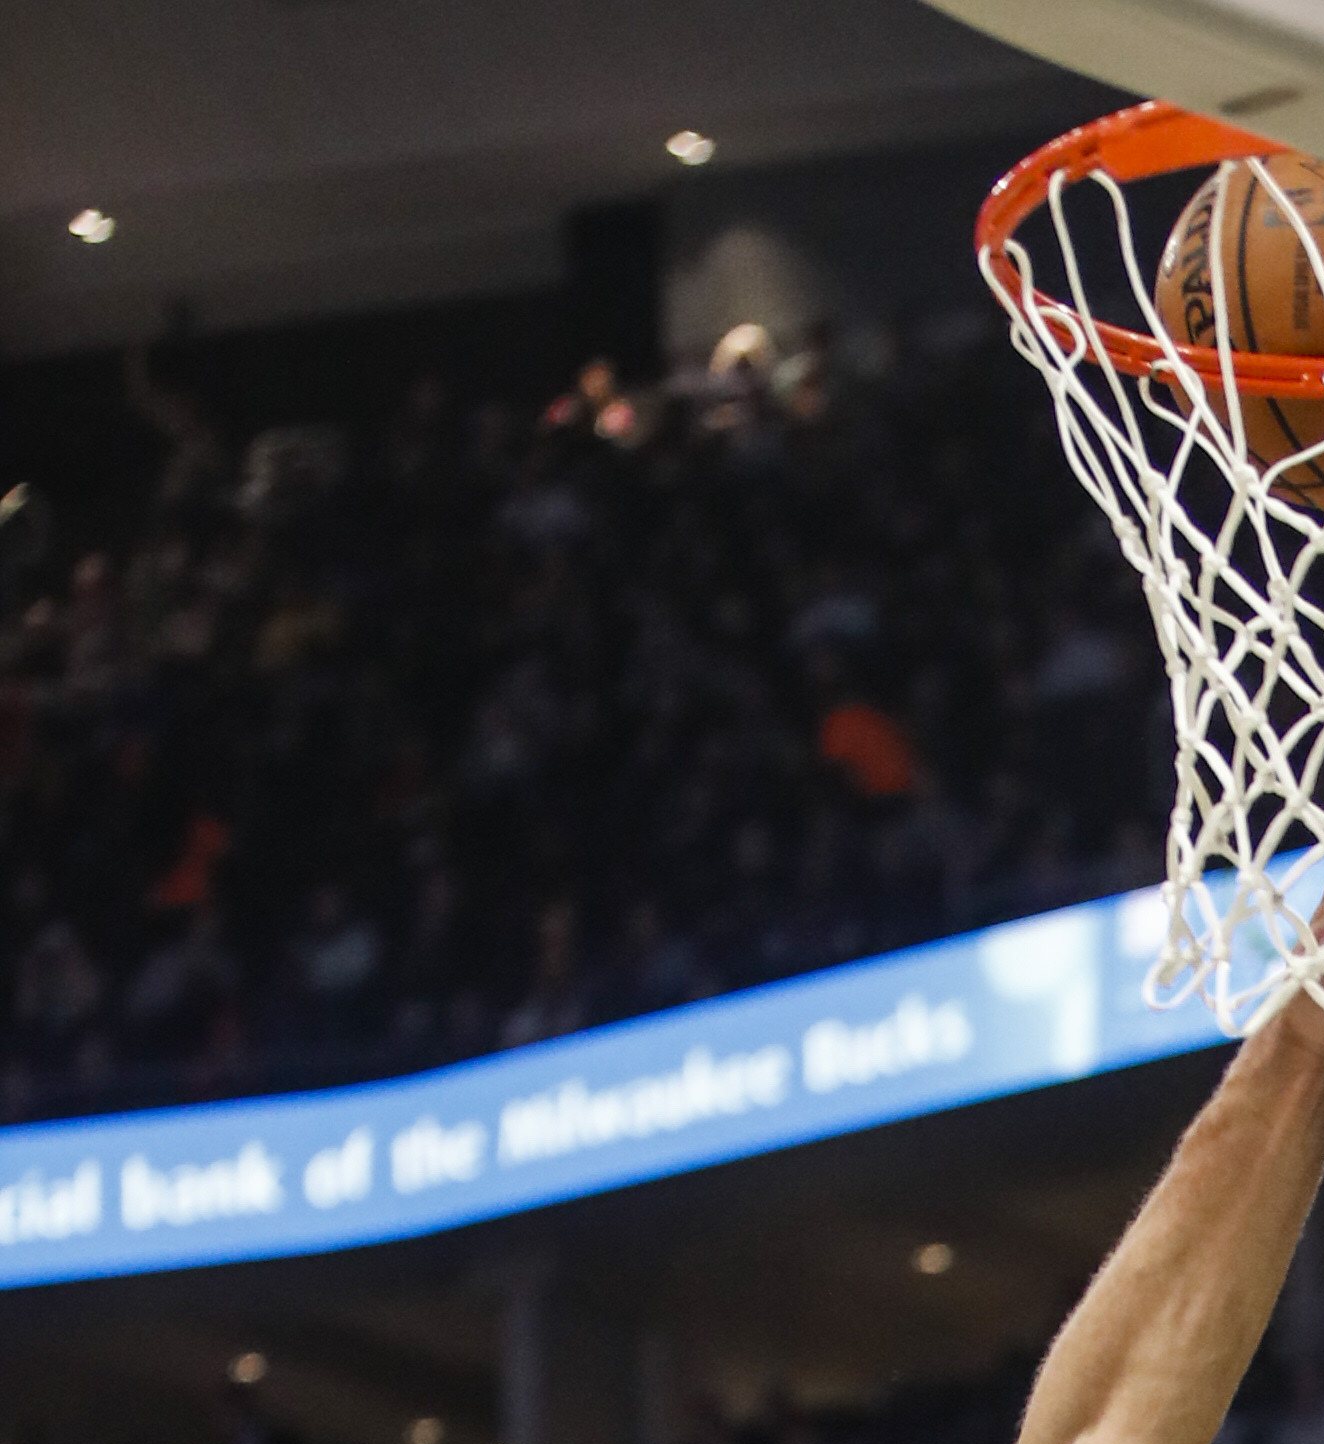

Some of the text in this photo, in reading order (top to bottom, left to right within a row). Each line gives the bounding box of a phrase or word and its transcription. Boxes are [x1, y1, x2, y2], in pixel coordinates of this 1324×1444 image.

[121, 1141, 281, 1230] bank
[305, 1125, 373, 1208] of
[391, 1116, 486, 1193] the
[499, 1045, 790, 1164] Milwaukee
[804, 998, 973, 1092] Bucks
